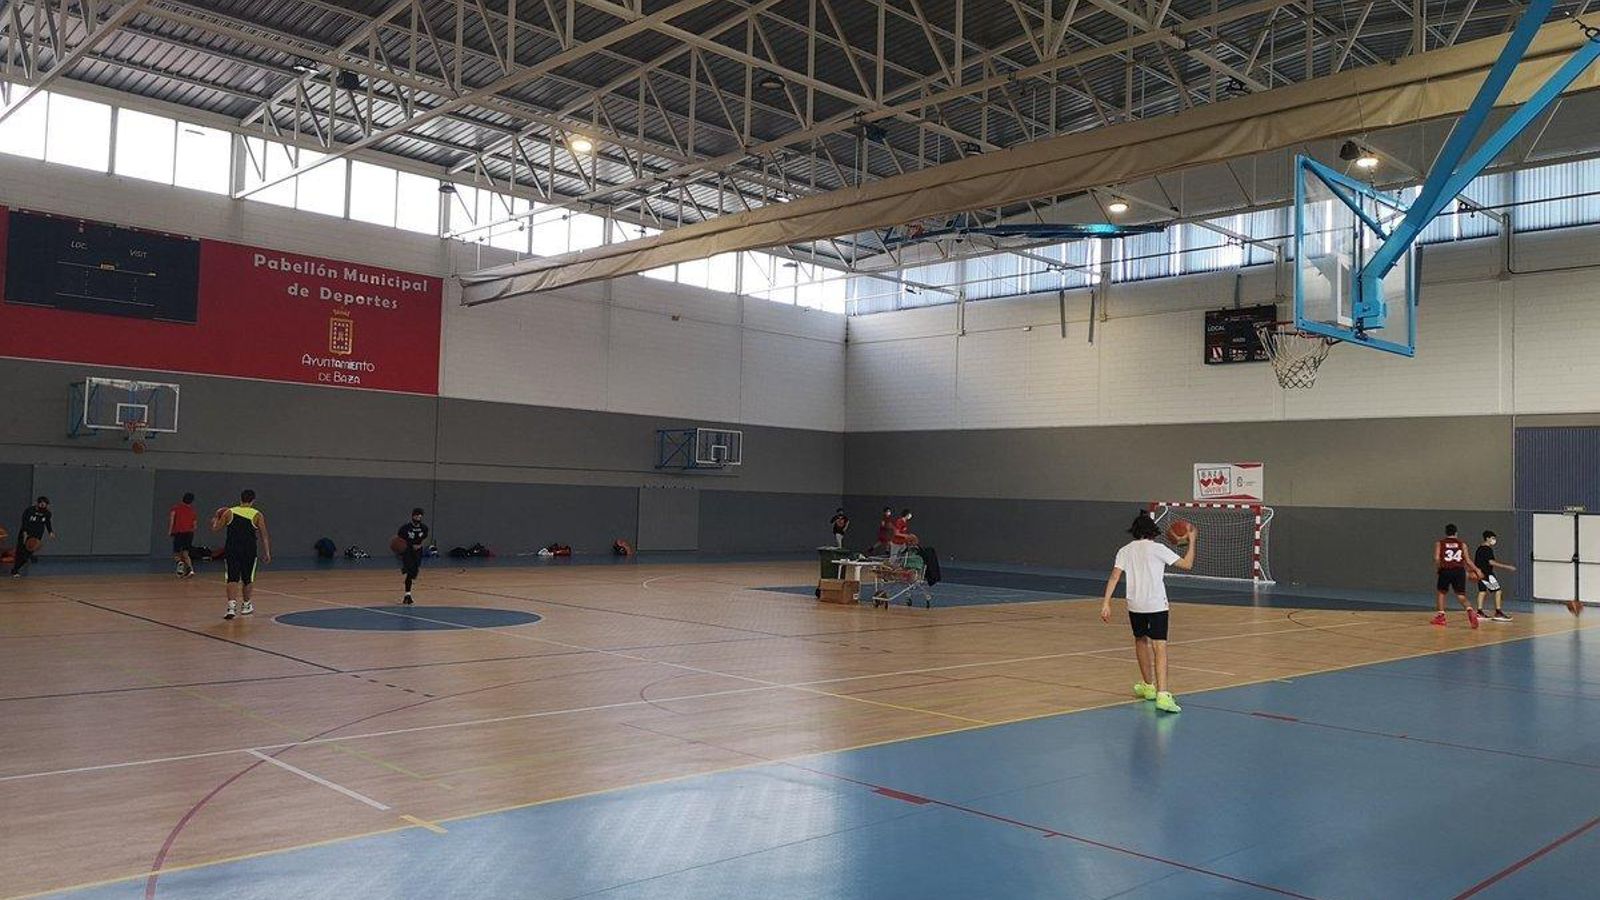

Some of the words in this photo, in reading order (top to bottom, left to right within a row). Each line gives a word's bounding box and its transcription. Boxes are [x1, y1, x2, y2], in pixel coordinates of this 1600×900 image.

[253, 253, 338, 279] Pabellón
[343, 267, 428, 293] Municipal
[287, 283, 310, 297] de
[320, 286, 399, 310] Deportes
[1207, 324, 1226, 332] LOCAL
[1444, 549, 1463, 562] 34
